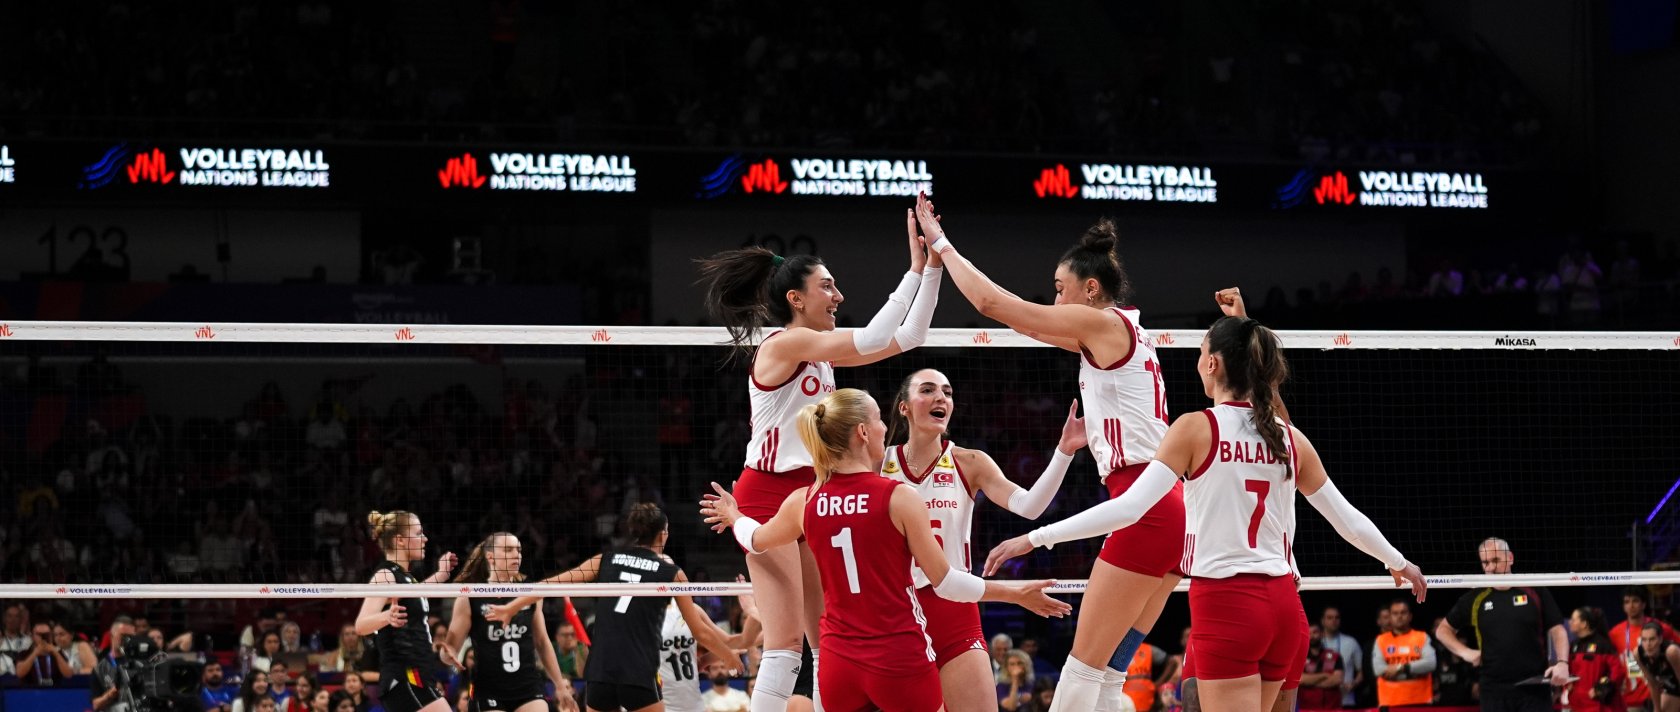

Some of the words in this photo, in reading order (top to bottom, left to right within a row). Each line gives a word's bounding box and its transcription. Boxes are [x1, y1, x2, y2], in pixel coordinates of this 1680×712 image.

[0, 145, 15, 166] L
[180, 148, 329, 170] VOLLEYBALL
[490, 153, 636, 176] VOLLEYBALL
[180, 170, 258, 186] NATIONS
[262, 171, 329, 187] LEAGUE
[791, 159, 933, 180] VOLLEYBALL
[1082, 164, 1217, 187] VOLLEYBALL
[490, 174, 567, 190] NATIONS
[570, 176, 636, 192] LEAGUE
[791, 180, 866, 195] NATIONS
[868, 181, 933, 196] LEAGUE
[1359, 171, 1488, 193] VOLLEYBALL
[1082, 185, 1153, 200] NATIONS
[1155, 186, 1217, 202] LEAGUE
[1360, 191, 1427, 207] NATIONS
[1430, 193, 1488, 208] LEAGUE
[0, 324, 13, 337] NL
[1220, 441, 1291, 465] BALAD
[816, 493, 869, 517] ÖRGE
[926, 498, 958, 509] afone
[1245, 479, 1270, 549] 7
[831, 527, 861, 594] 1
[614, 571, 641, 614] 7
[488, 624, 528, 641] Lotto
[502, 641, 521, 672] 9
[666, 651, 695, 681] 18
